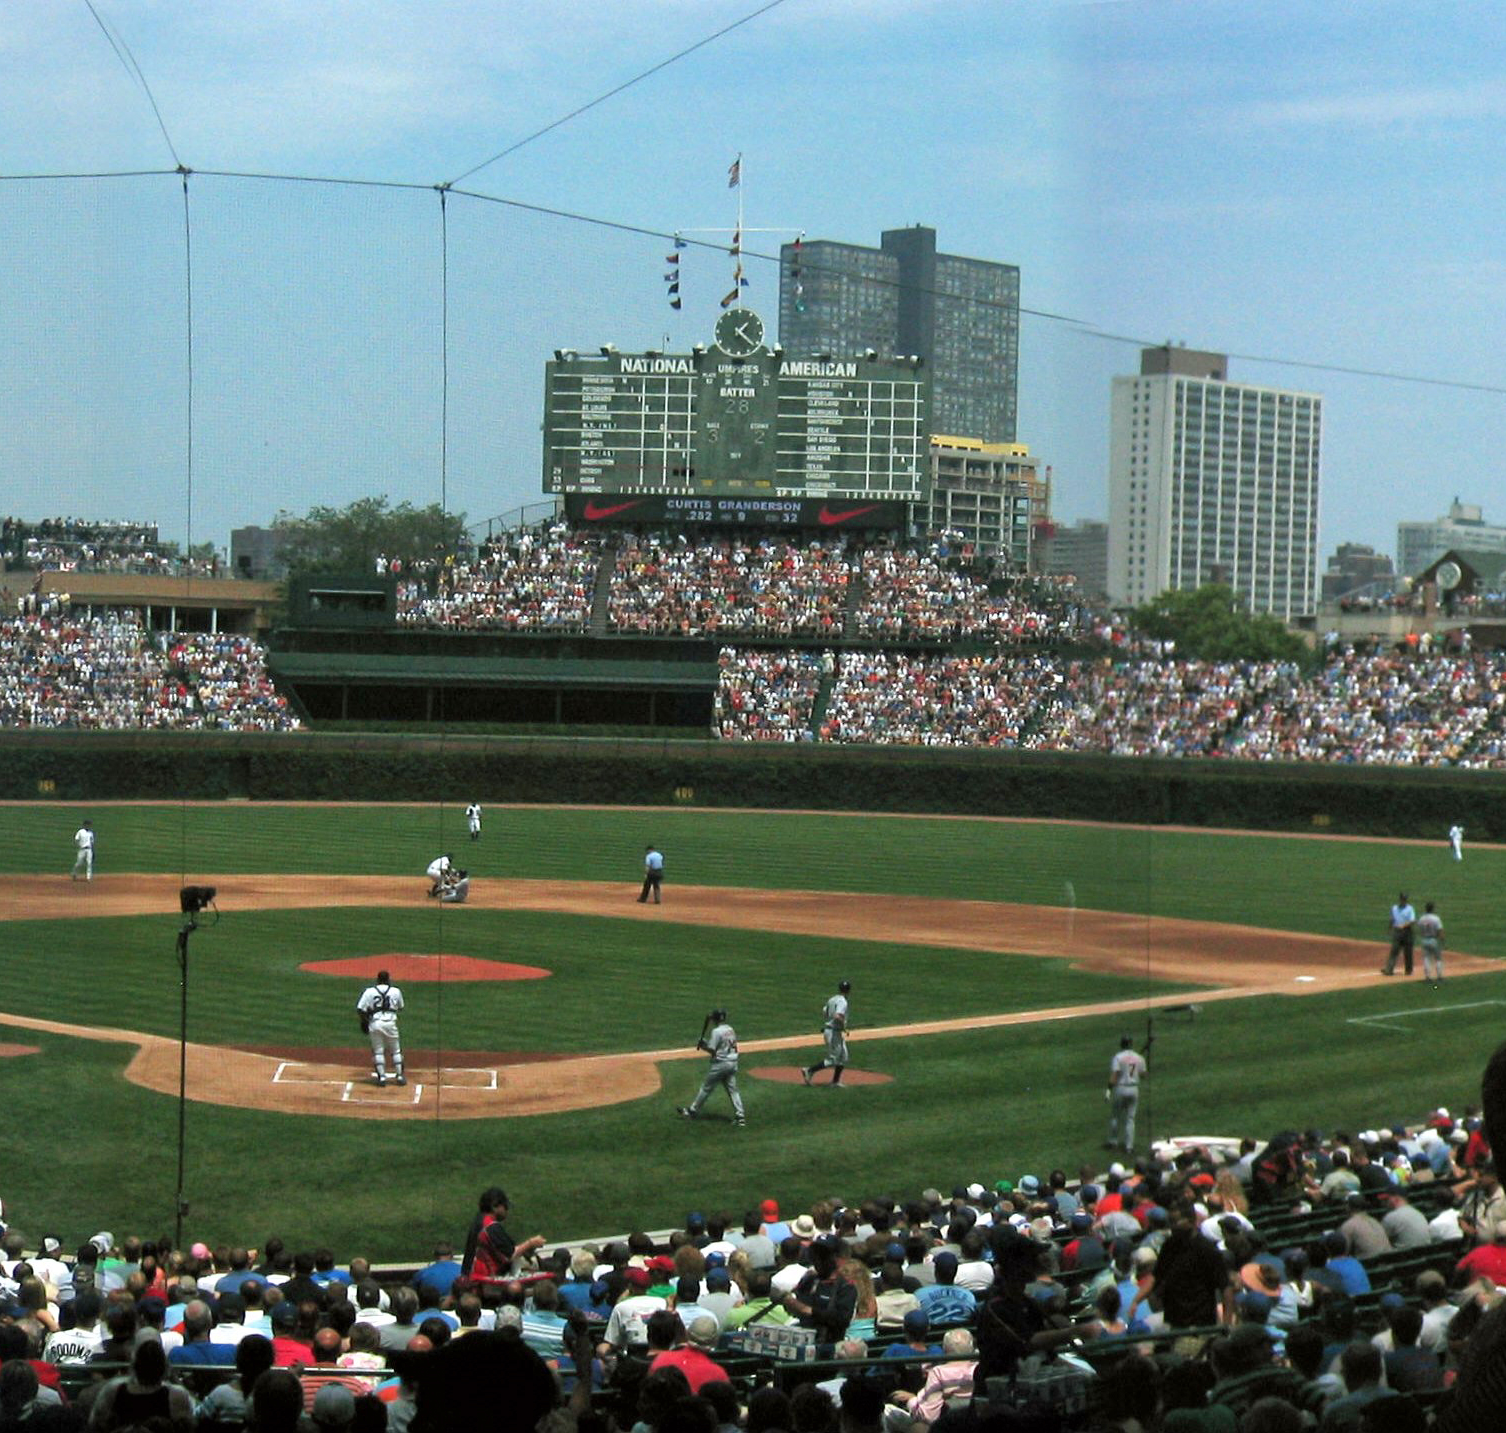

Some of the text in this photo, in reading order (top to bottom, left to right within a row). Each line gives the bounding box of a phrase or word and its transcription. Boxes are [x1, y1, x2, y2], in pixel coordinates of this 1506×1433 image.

[620, 358, 697, 373] NATIONAL
[718, 364, 759, 374] UMPIRES
[779, 361, 857, 377] AMERICAN
[720, 388, 755, 398] BATTER
[725, 399, 749, 414] 28
[709, 429, 718, 443] 3
[755, 430, 765, 444] 2
[667, 500, 801, 511] CURTIS GRANDERSON
[782, 513, 798, 523] 32
[1129, 1063, 1136, 1077] 7
